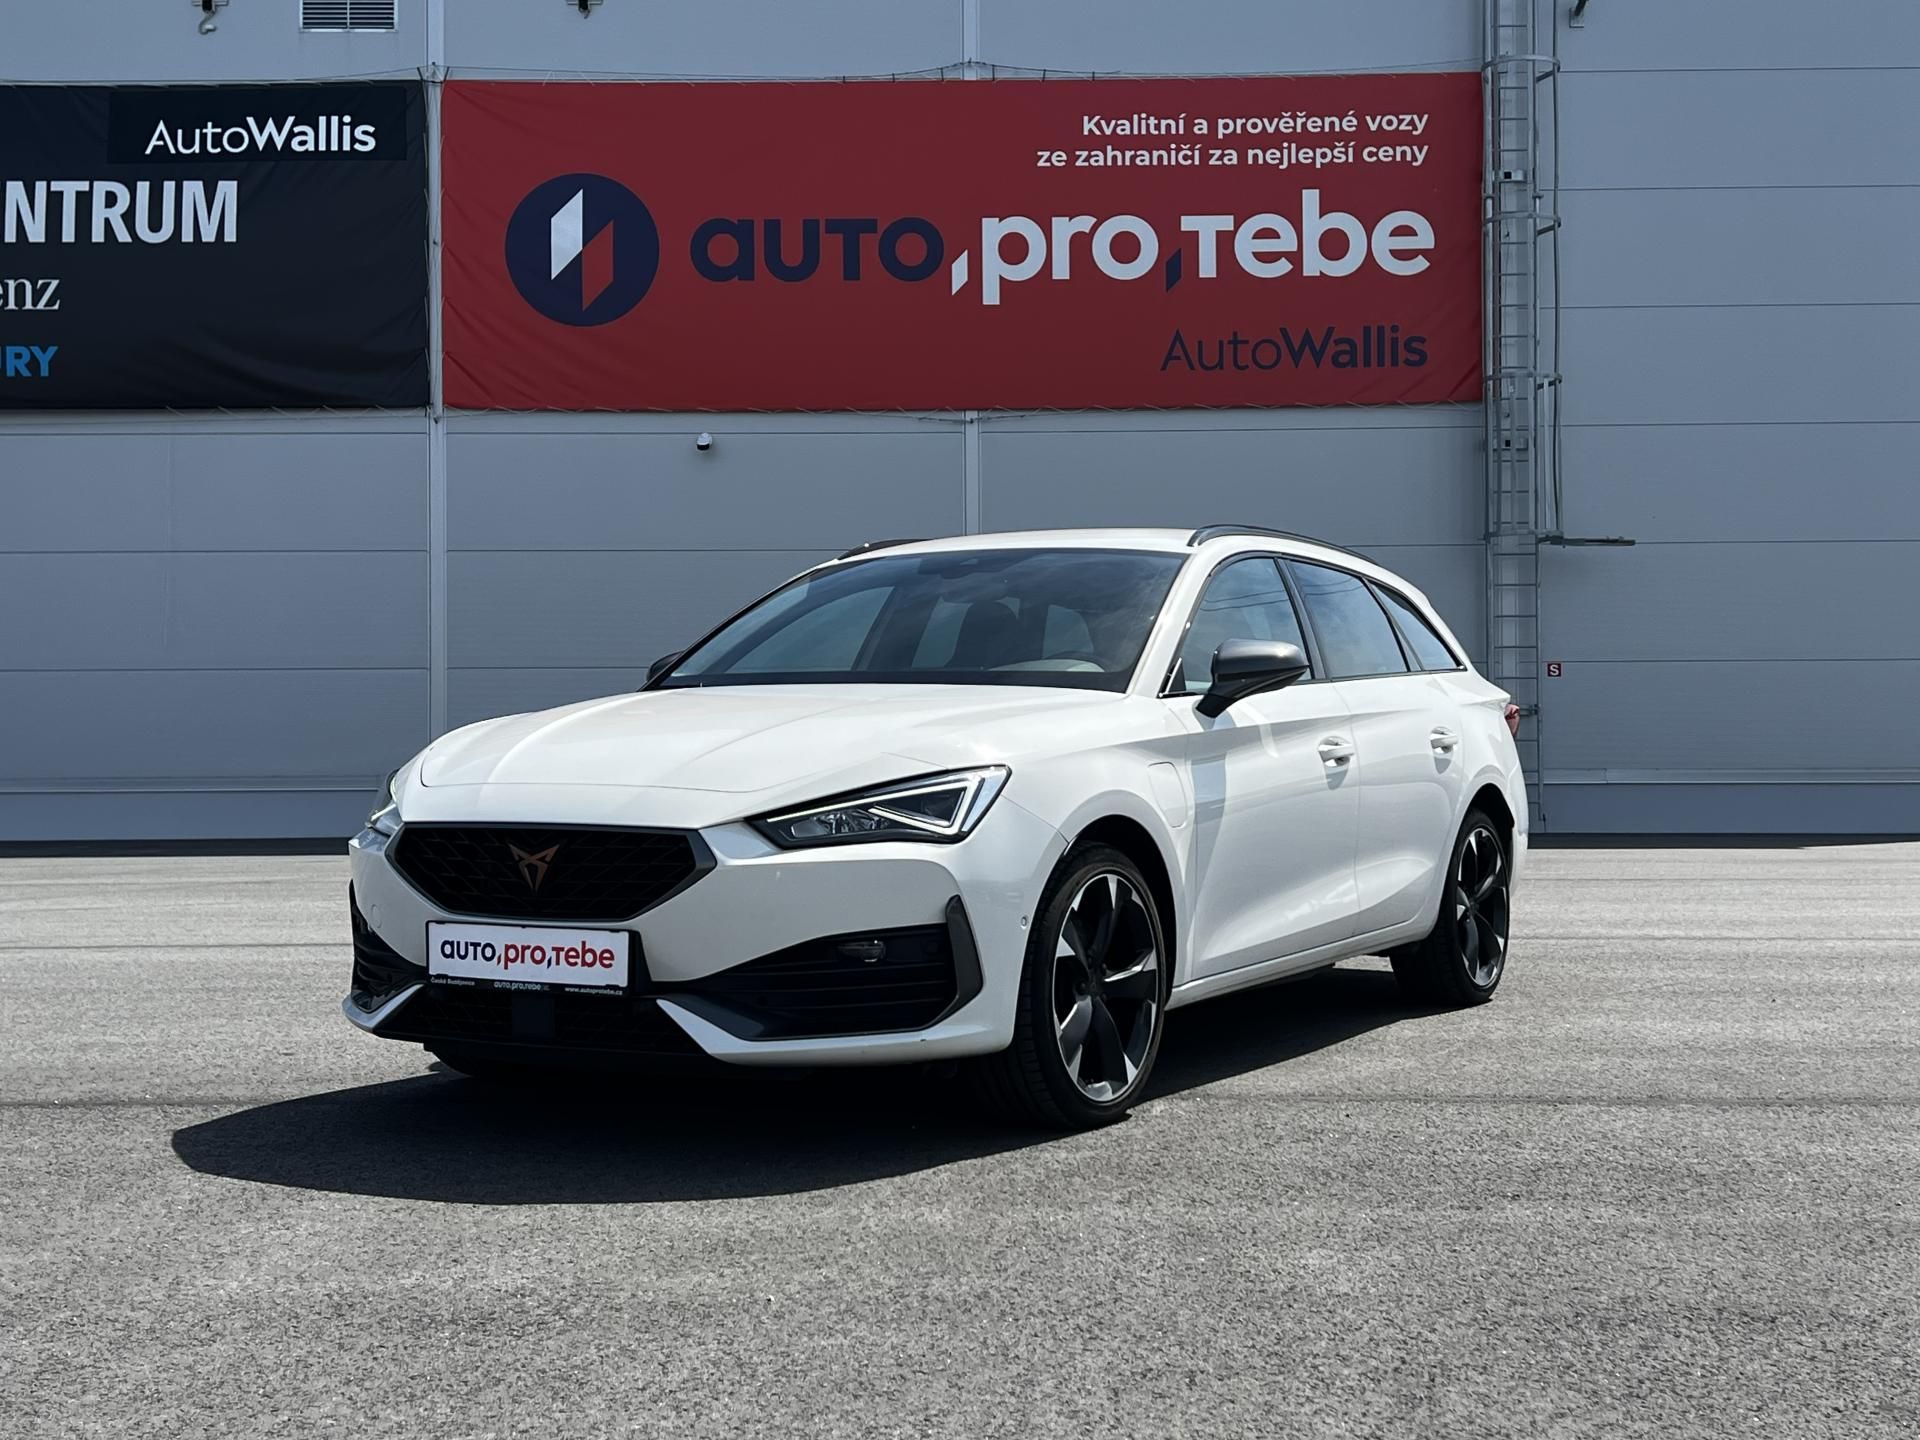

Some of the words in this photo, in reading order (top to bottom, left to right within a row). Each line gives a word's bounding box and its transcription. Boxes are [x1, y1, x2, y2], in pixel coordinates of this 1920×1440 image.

[144, 114, 377, 155] AutoWallis
[1082, 112, 1186, 136] Kvalitní
[1193, 117, 1209, 135] a
[1217, 110, 1358, 139] prověřené
[1365, 112, 1429, 136] vozy
[1036, 150, 1068, 168] ze
[1075, 144, 1201, 167] zahraničí
[1208, 148, 1239, 166] za
[1247, 141, 1356, 169] nejlepší
[1362, 142, 1429, 166] ceny
[0, 278, 60, 311] nz
[0, 345, 58, 377] RY
[1160, 325, 1429, 371] AutoWallis
[1549, 664, 1560, 676] S
